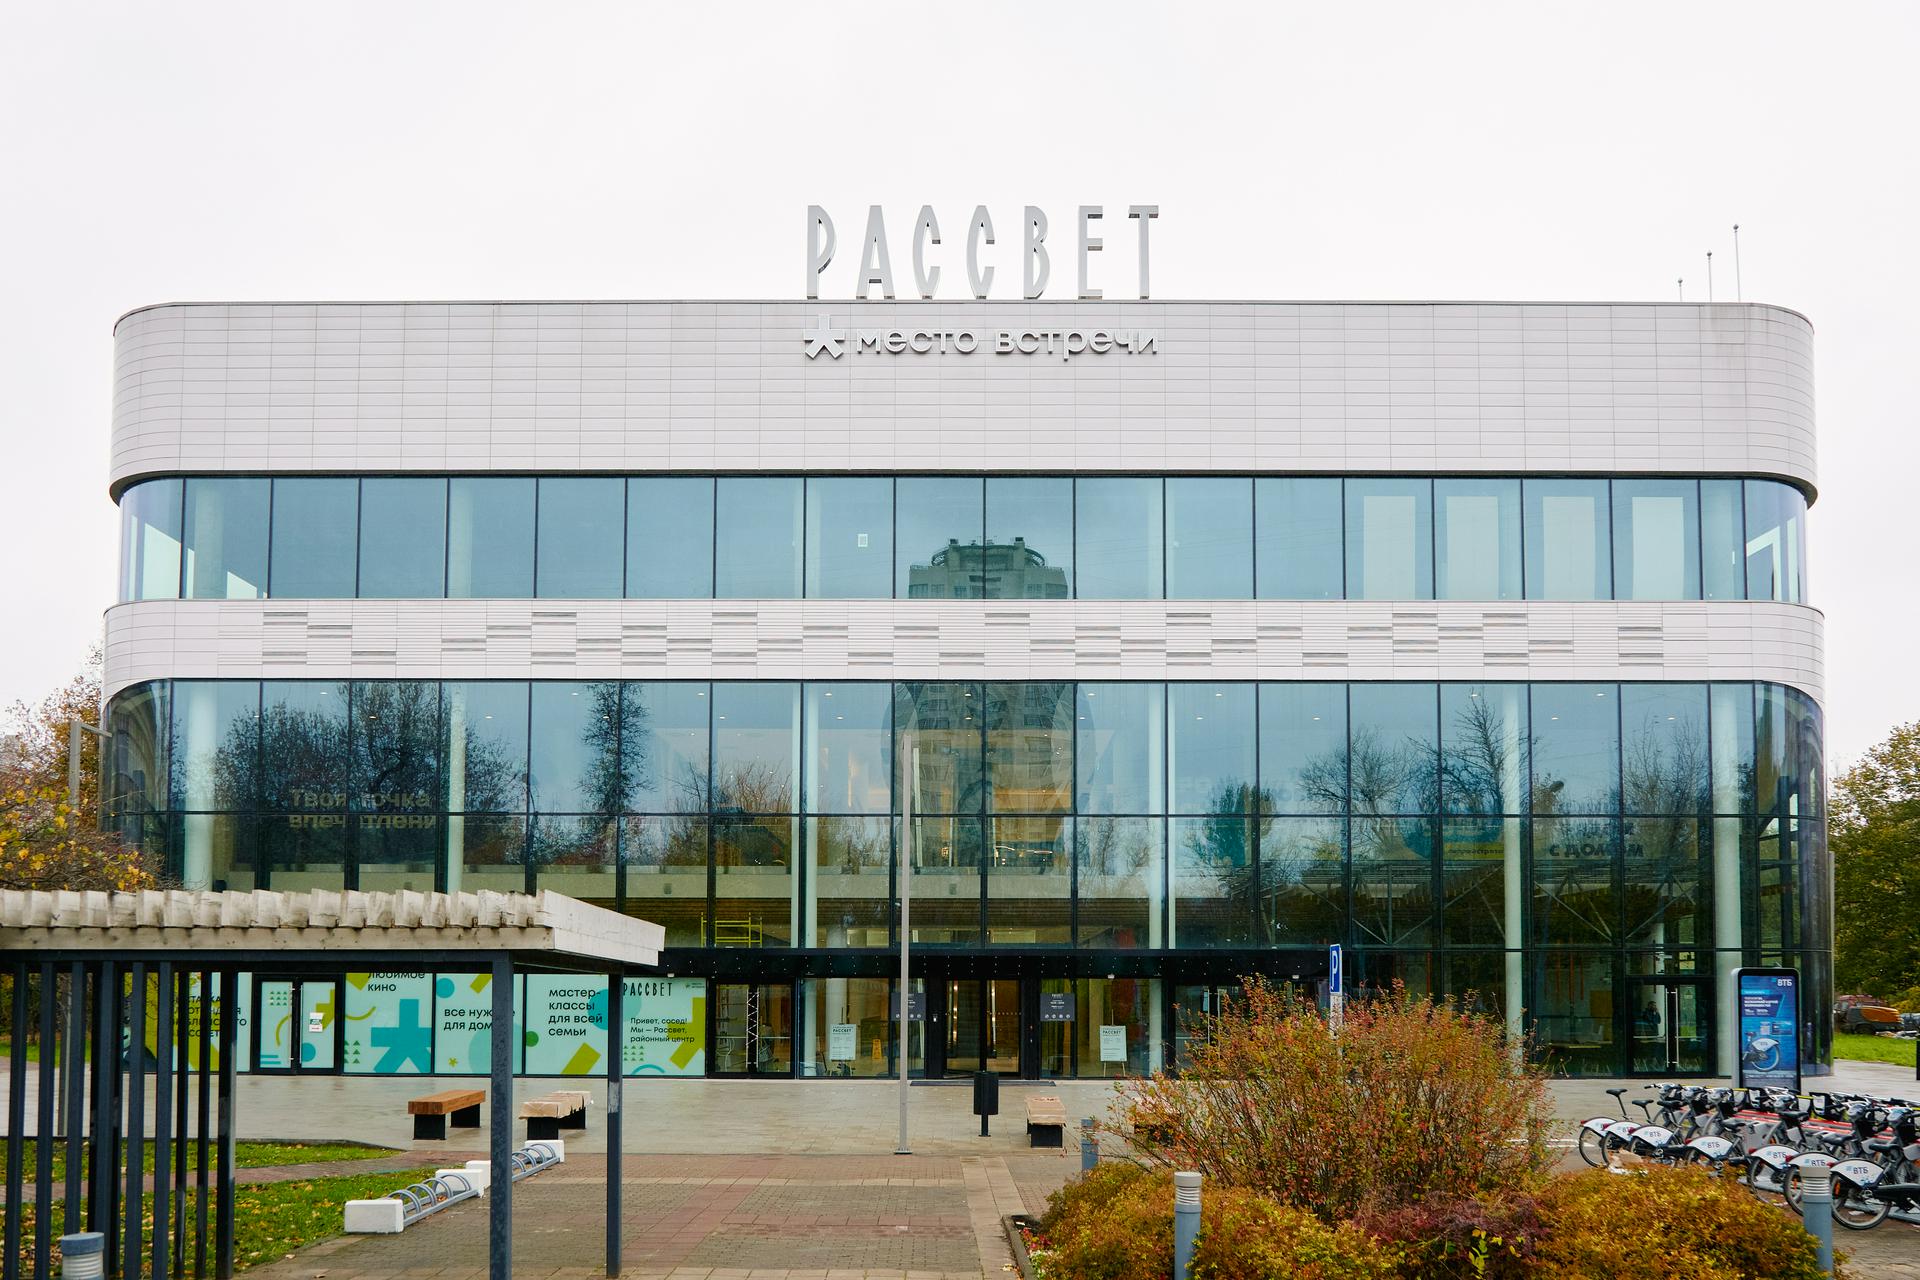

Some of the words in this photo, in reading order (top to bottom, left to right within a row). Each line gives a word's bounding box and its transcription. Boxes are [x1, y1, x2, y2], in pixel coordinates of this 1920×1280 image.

[806, 204, 1159, 299] РАССВЕТ
[856, 328, 979, 354] место
[995, 328, 1159, 361] встречи
[1331, 950, 1338, 989] P
[367, 983, 397, 992] кино
[1777, 979, 1793, 987] ВТБ
[549, 988, 601, 1000] мастер-
[623, 982, 673, 997] РАССВЕТ
[549, 1001, 595, 1011] классы
[444, 1009, 466, 1018] все
[548, 1014, 571, 1025] для
[574, 1012, 603, 1024] всей
[630, 1017, 660, 1026] Привет,
[661, 1017, 688, 1026] сосед!
[443, 1021, 466, 1031] для
[468, 1021, 493, 1031] дом
[630, 1026, 645, 1034] Мы
[653, 1026, 687, 1035] Рассвет,
[548, 1028, 587, 1037] семьи
[630, 1035, 670, 1044] районный
[671, 1036, 695, 1044] центр
[1853, 1167, 1869, 1175] ВТБ
